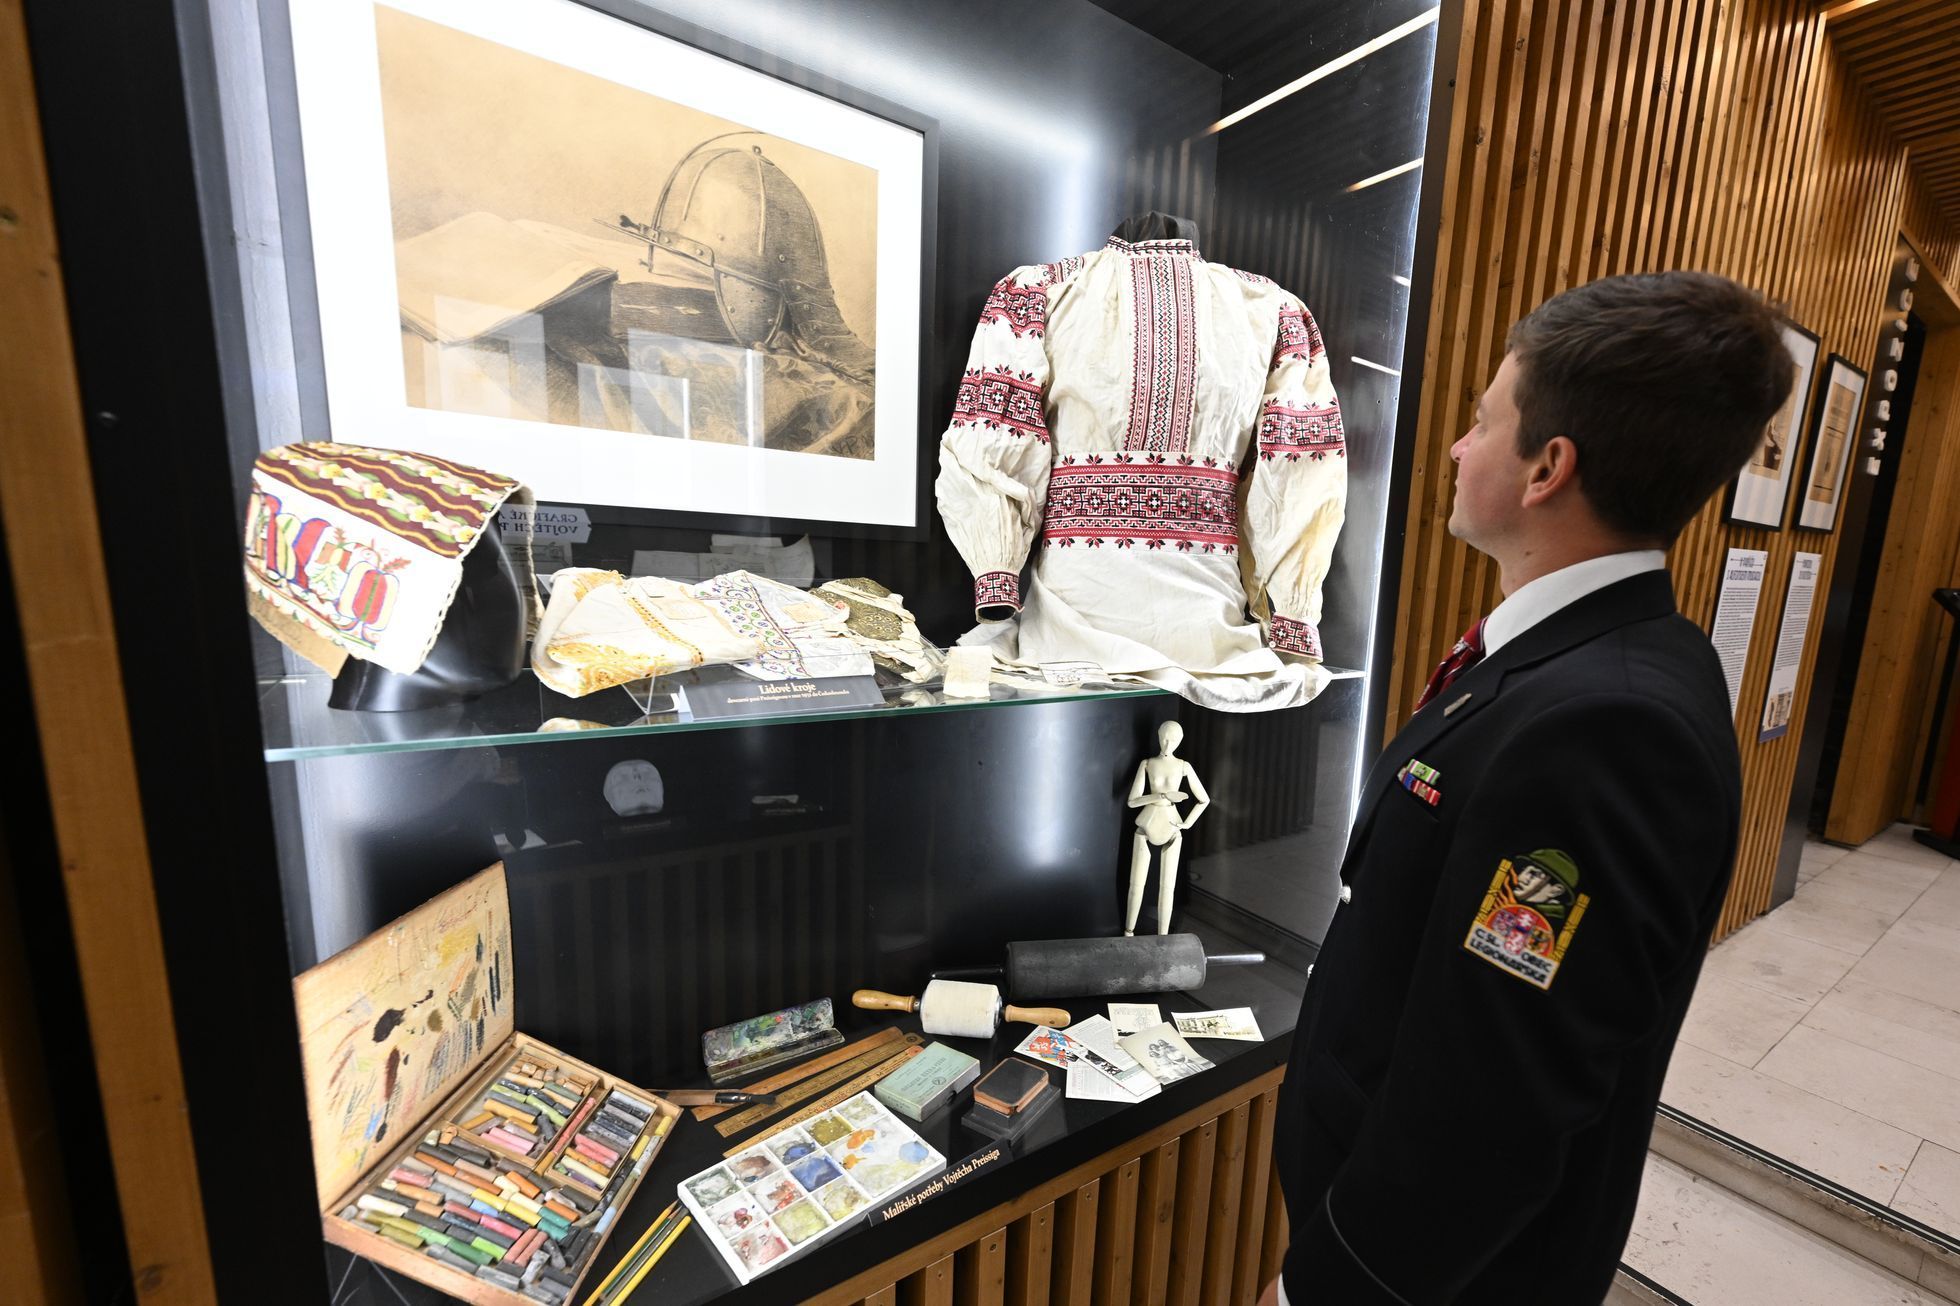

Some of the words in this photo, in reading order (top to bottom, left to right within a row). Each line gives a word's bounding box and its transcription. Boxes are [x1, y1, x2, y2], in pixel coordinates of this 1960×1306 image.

[758, 683, 791, 695] Lidové
[790, 682, 817, 693] kroje
[882, 1194, 916, 1220] Malířské
[917, 1180, 944, 1204] potřeby
[942, 1164, 973, 1186] Vojtěcha
[971, 1148, 1000, 1170] Preissiga
